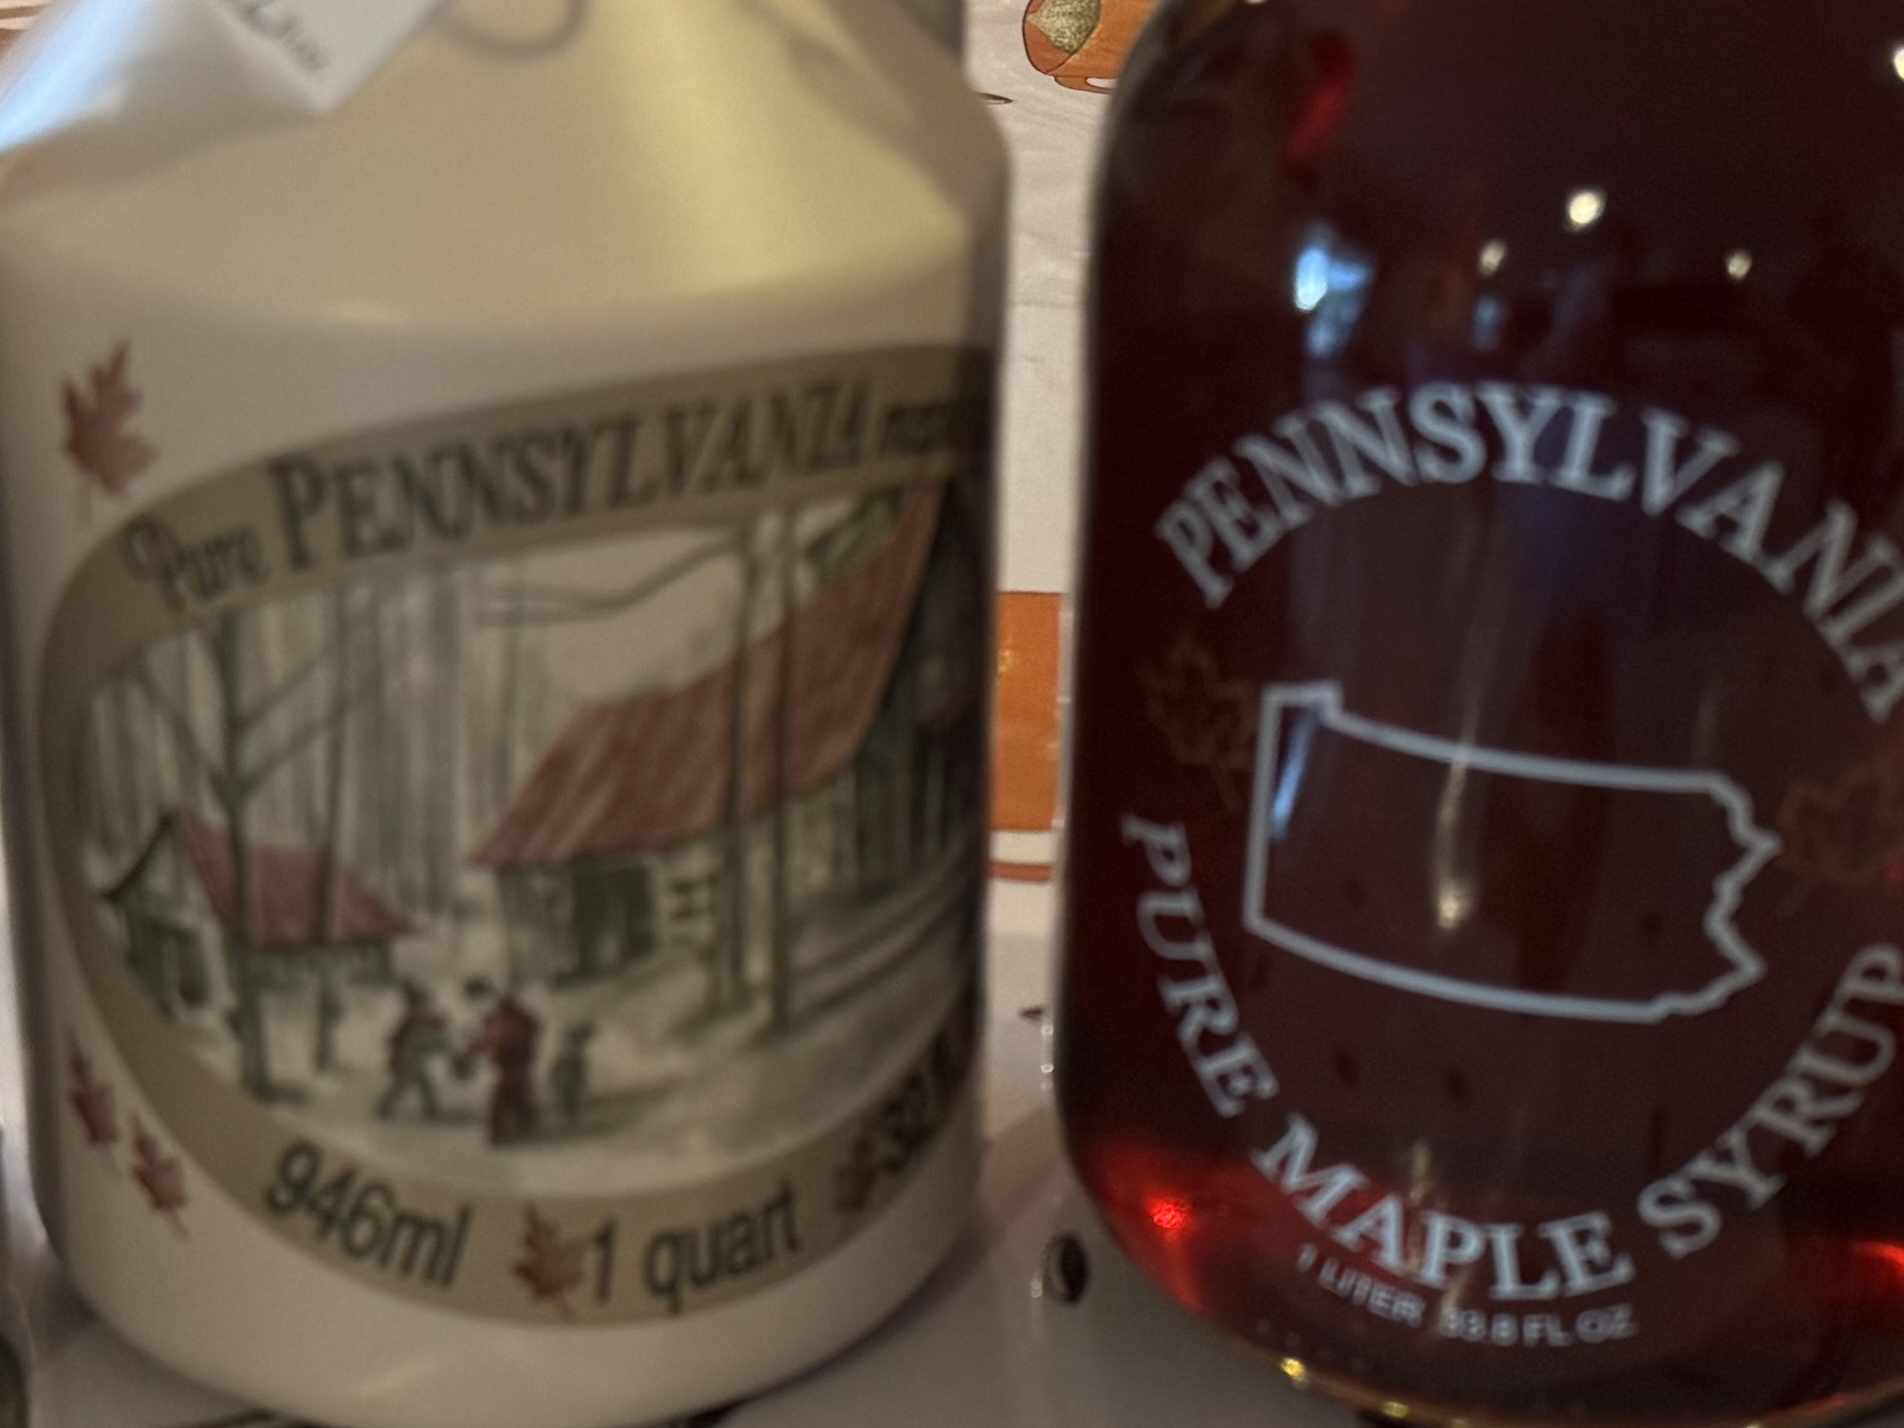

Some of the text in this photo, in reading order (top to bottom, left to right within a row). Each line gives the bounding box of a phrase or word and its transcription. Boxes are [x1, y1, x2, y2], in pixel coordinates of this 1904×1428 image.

[266, 375, 872, 574] PENNSYLVANIA
[1121, 810, 1280, 1118] PURE
[1250, 1115, 1636, 1302] MAPLE
[264, 1140, 472, 1291] 946ml
[589, 1219, 618, 1302] 1
[642, 1178, 803, 1317] quart
[1297, 1242, 1320, 1273] 1
[1319, 1256, 1427, 1328] LITER
[1521, 1312, 1574, 1349] FL
[1575, 1302, 1640, 1345] OZ
